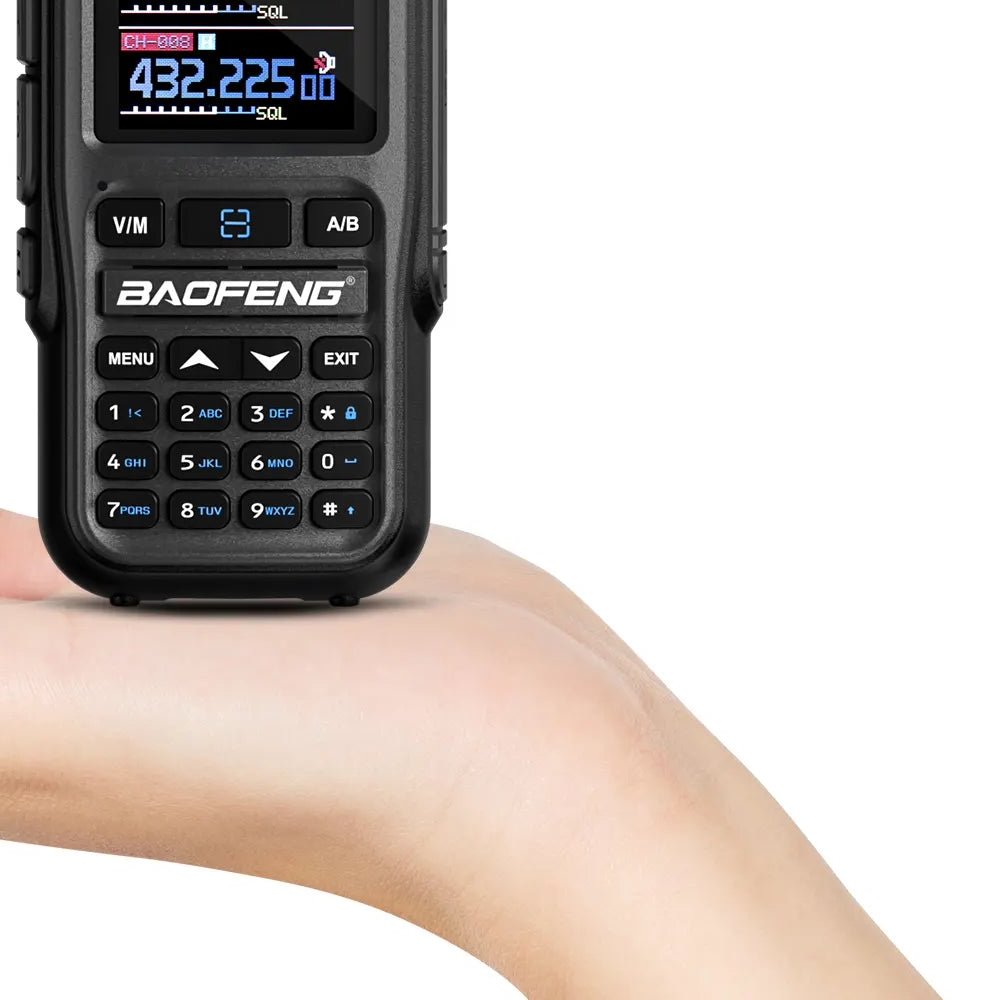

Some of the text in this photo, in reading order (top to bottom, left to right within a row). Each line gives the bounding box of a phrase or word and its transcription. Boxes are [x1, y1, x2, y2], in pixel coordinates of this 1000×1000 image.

[257, 6, 288, 19] SQL
[124, 35, 190, 49] CH-008
[256, 107, 287, 120] SQL
[113, 216, 147, 234] V/M
[327, 216, 359, 231] A/B
[109, 352, 154, 365] MENU
[325, 352, 359, 365] EXIT
[110, 405, 118, 420] 1
[181, 405, 222, 421] 2 ABC
[251, 406, 293, 422] 3 DEF
[107, 454, 146, 469] 4 GHI
[181, 455, 222, 470] 5 JKL
[251, 455, 293, 470] 6 MNO
[322, 454, 333, 469] 0
[108, 502, 150, 517] 7 PQRS
[181, 503, 222, 518] 8 TUV
[251, 503, 294, 518] 9 WXYZ
